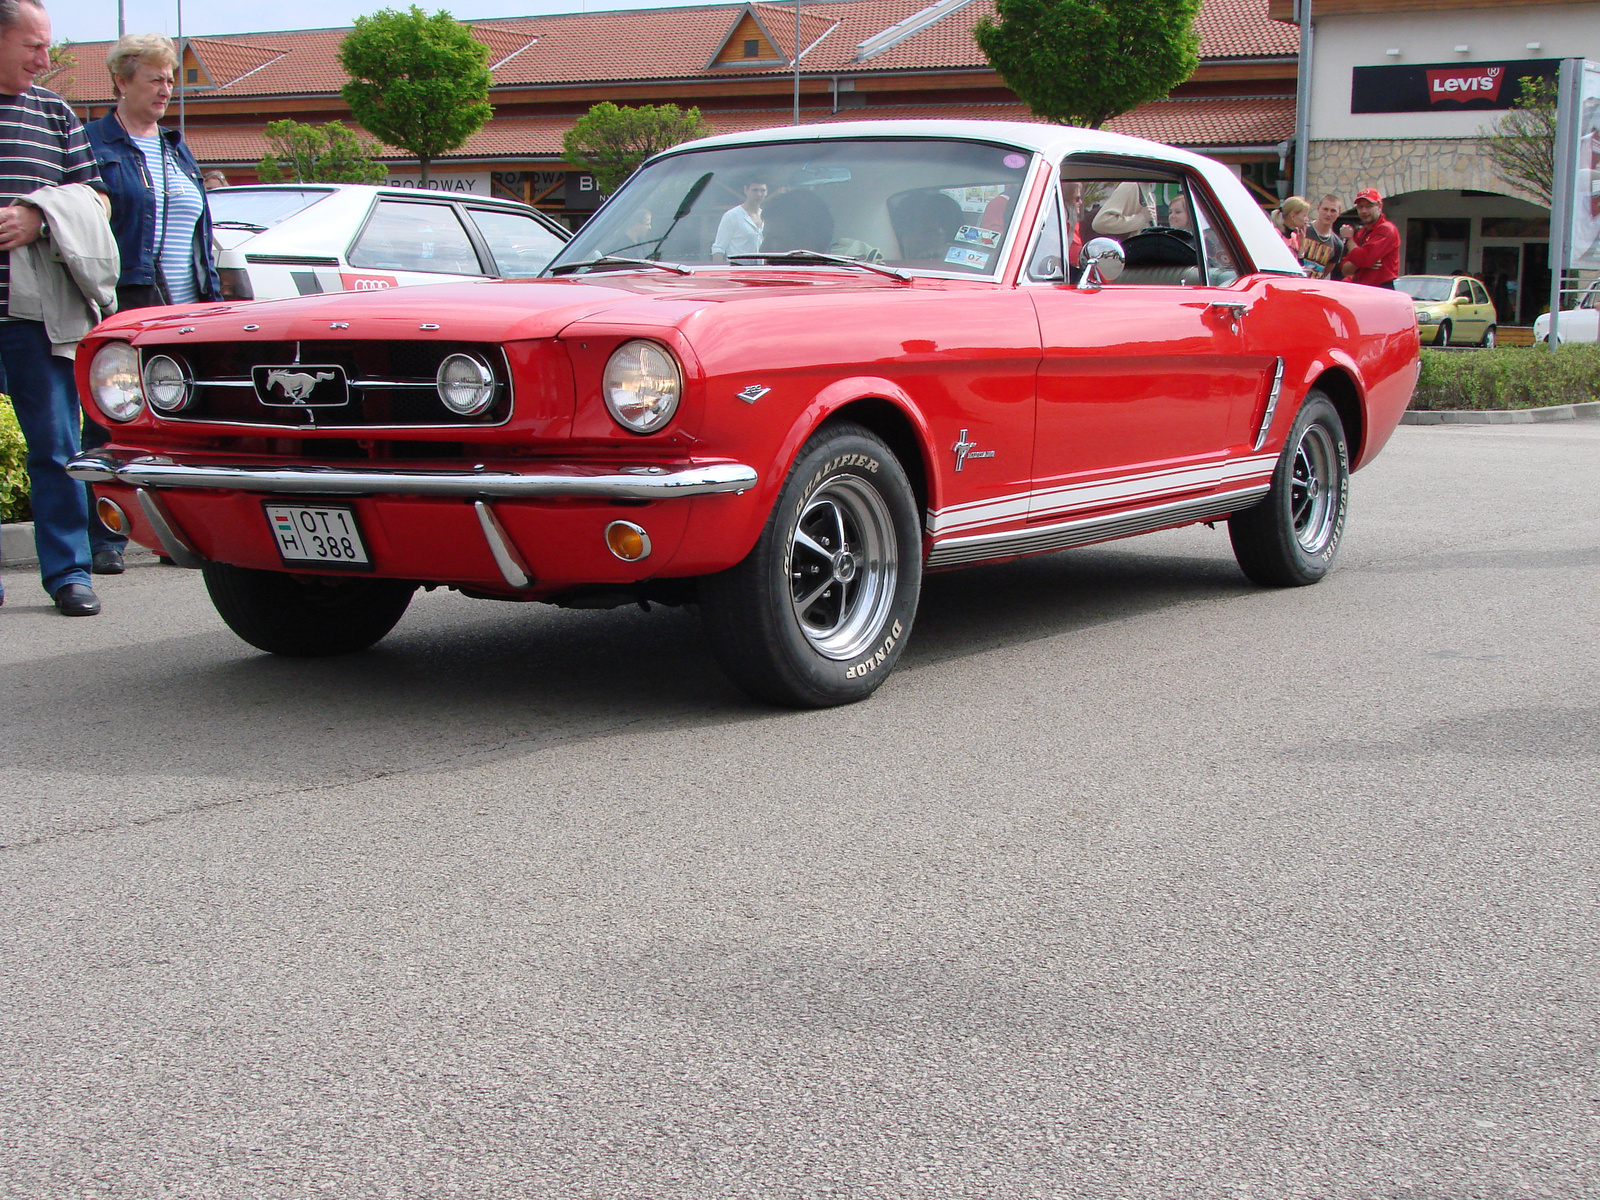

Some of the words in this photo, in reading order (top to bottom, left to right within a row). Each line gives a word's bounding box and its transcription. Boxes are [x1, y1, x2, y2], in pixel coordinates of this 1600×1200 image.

[796, 453, 880, 518] QUALIFIER
[281, 534, 299, 551] H
[312, 535, 356, 559] 388
[845, 618, 903, 679] DUNLOP
